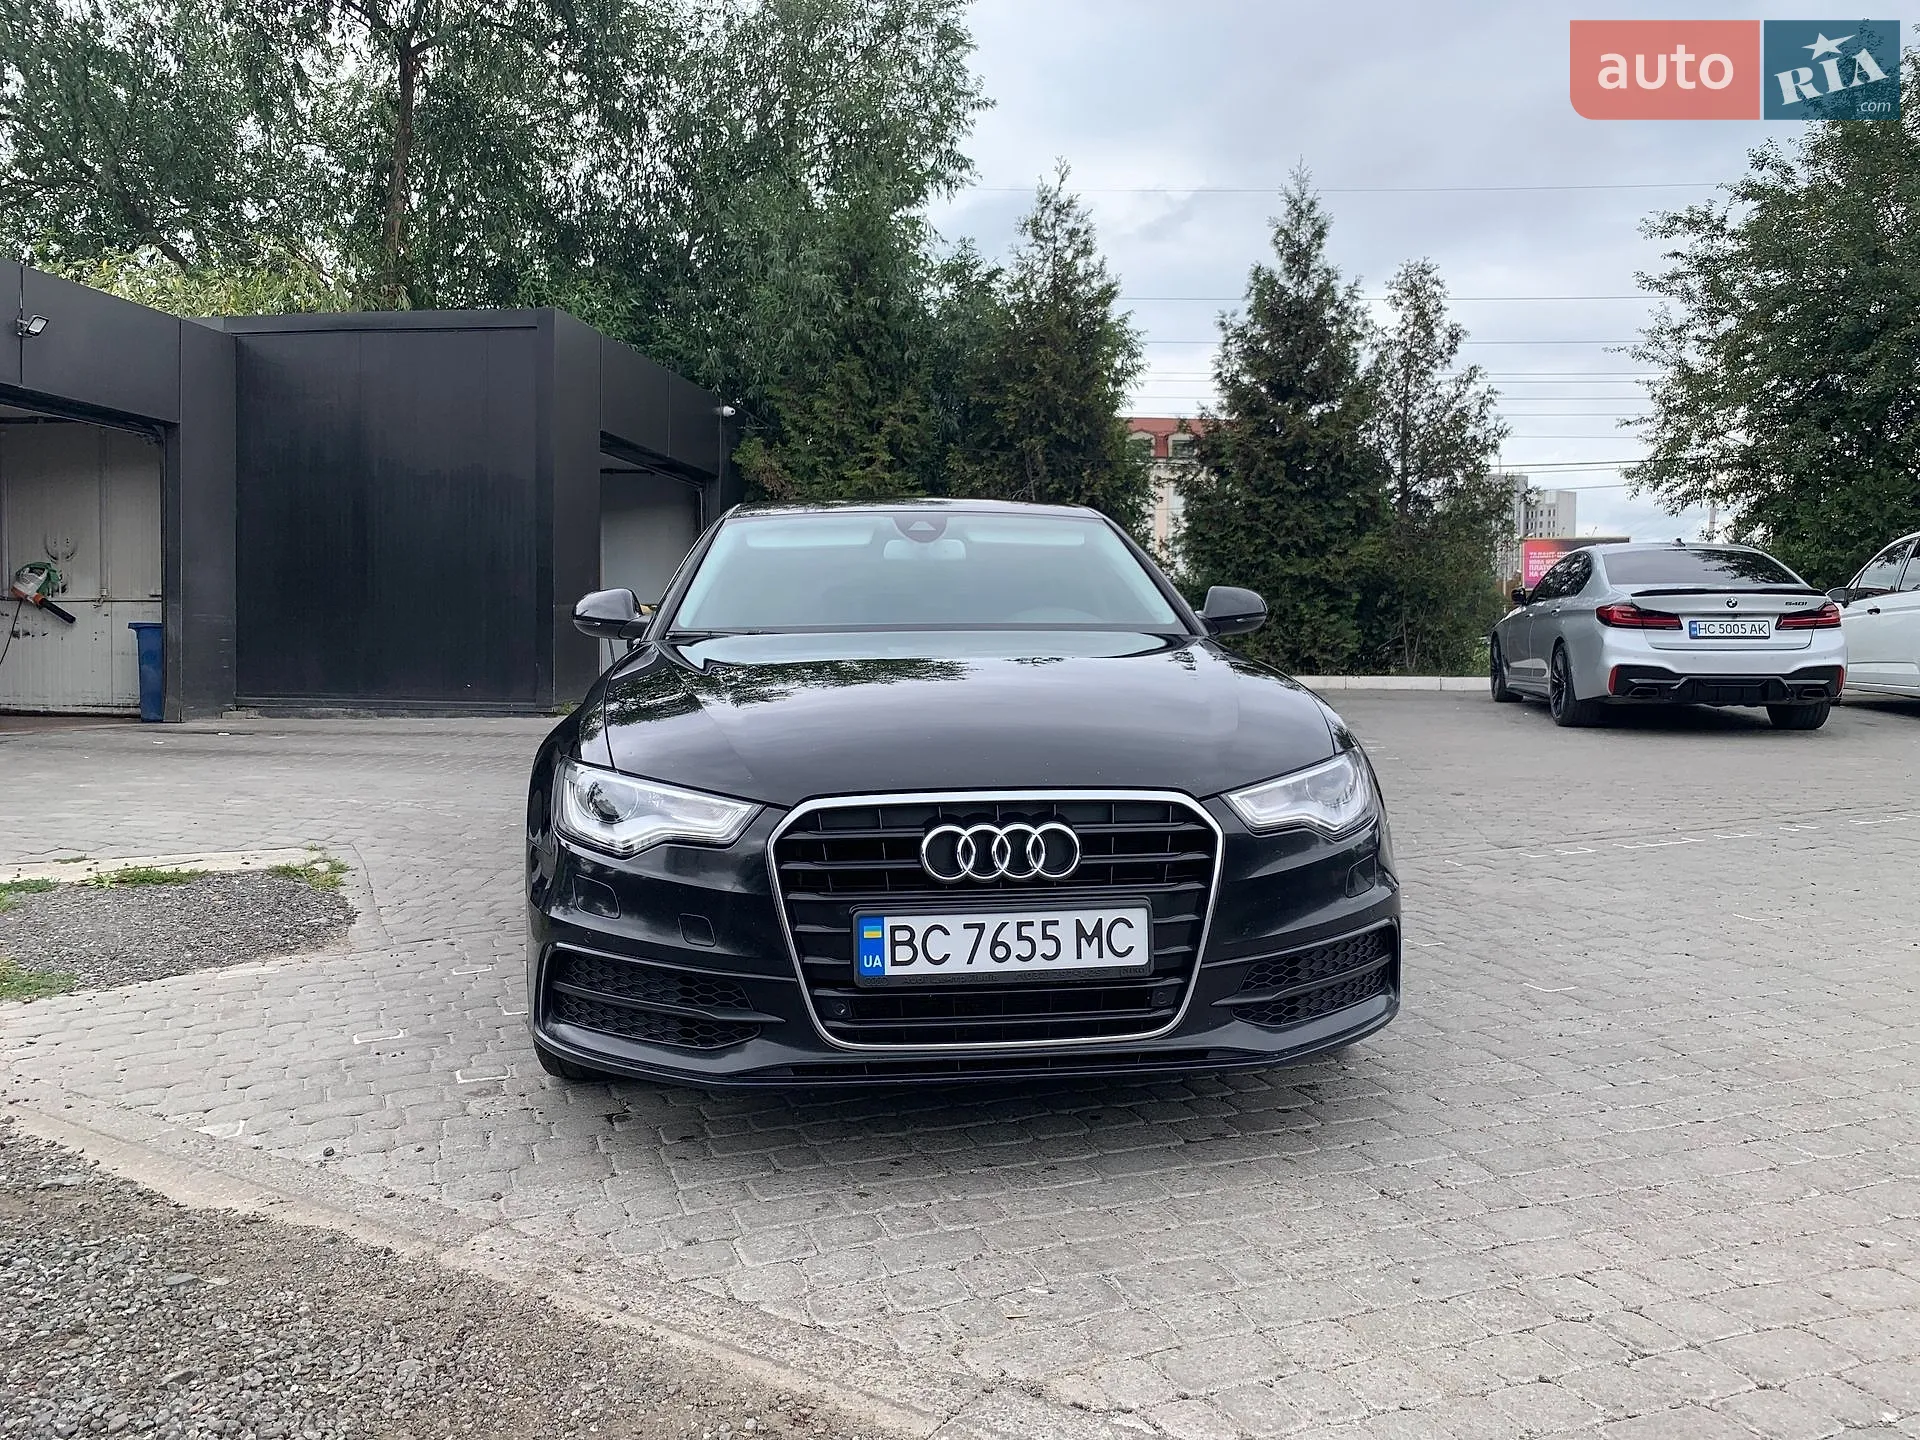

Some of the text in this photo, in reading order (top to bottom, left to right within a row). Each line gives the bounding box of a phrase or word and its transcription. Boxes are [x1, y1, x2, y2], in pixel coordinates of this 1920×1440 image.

[1698, 624, 1715, 634] HC
[1718, 624, 1747, 634] 5005
[1750, 624, 1767, 634] AK
[889, 917, 1135, 966] BC 7655 MC
[864, 955, 882, 968] UA
